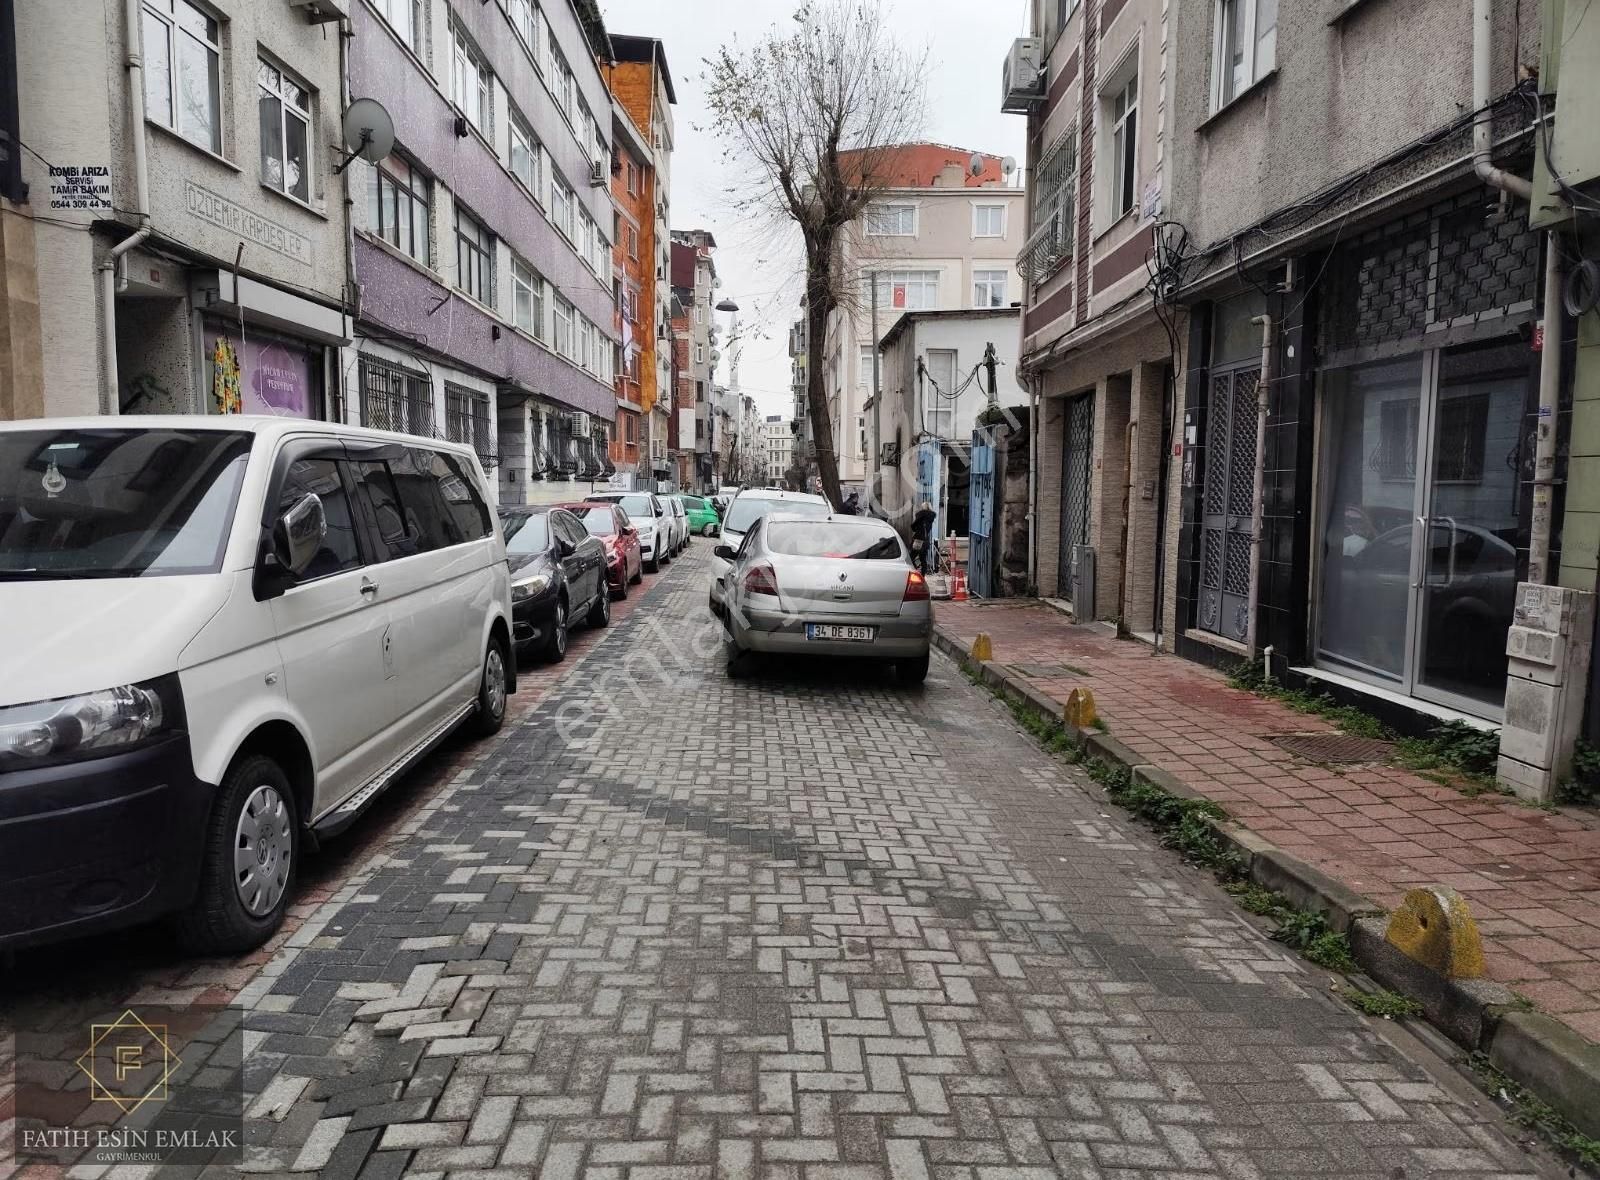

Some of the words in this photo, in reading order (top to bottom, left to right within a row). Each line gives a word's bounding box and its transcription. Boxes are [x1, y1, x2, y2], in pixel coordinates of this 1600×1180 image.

[82, 166, 109, 176] ARIZA
[81, 185, 110, 194] BAKIM
[51, 200, 71, 208] 0544
[89, 200, 99, 208] 44
[814, 625, 826, 637] 34
[832, 626, 843, 638] DE
[847, 627, 871, 639] 8361
